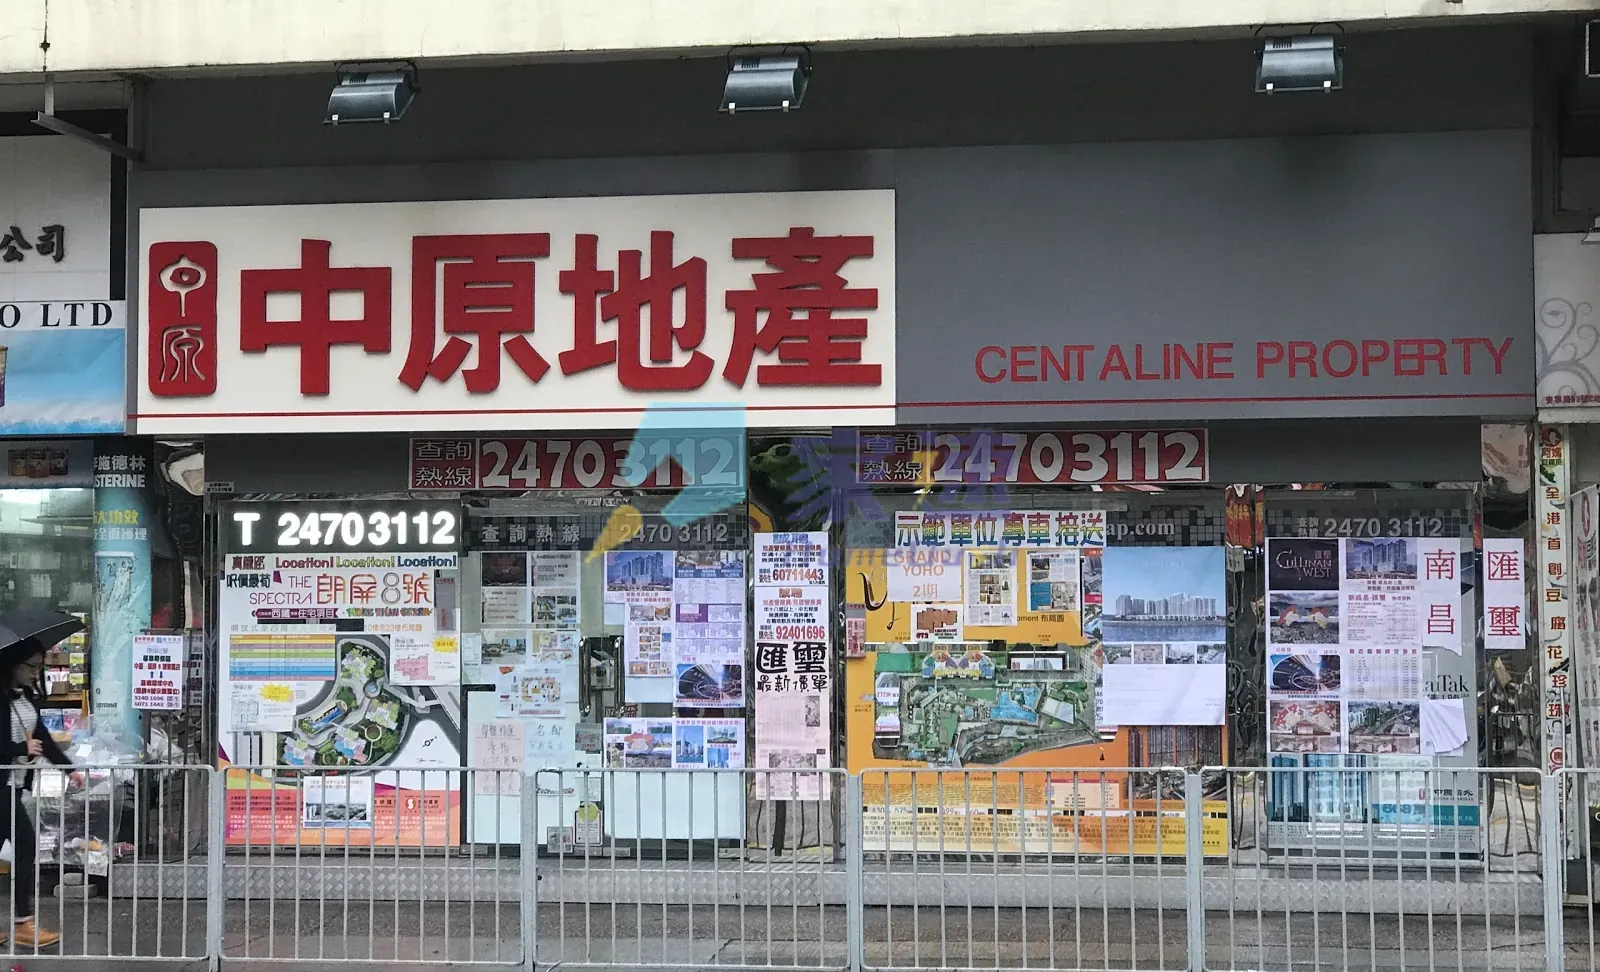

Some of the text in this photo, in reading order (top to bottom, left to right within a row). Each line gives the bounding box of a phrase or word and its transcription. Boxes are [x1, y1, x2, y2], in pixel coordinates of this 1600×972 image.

[0, 225, 65, 263] 公司
[40, 303, 113, 327] LTD
[240, 227, 882, 396] 中原地產
[974, 337, 1514, 385] CENTALINE PROPERTY
[415, 441, 472, 460] 查詢
[863, 433, 922, 453] 查詢
[481, 438, 738, 488] 24703112
[933, 431, 1203, 482] 24703112
[415, 466, 472, 487] 熱線
[863, 459, 922, 480] 熱線
[233, 512, 261, 546] T
[620, 523, 671, 542] 2470
[678, 523, 728, 542] 3112
[897, 511, 1104, 547] 示範單位專車接送
[1324, 518, 1443, 537] 2470 3112
[276, 555, 457, 568] Location! Location! Location!
[894, 550, 952, 564] GRAND
[773, 569, 824, 581] 60711443
[903, 565, 945, 577] YOHO
[1303, 568, 1332, 578] WEST
[289, 576, 312, 588] THE
[913, 584, 938, 599] 2期
[249, 592, 313, 605] SPECTRA
[1423, 549, 1456, 635] 南昌
[1487, 550, 1522, 636] 匯璽
[776, 626, 826, 640] 92401696
[1424, 675, 1470, 692] aiTak
